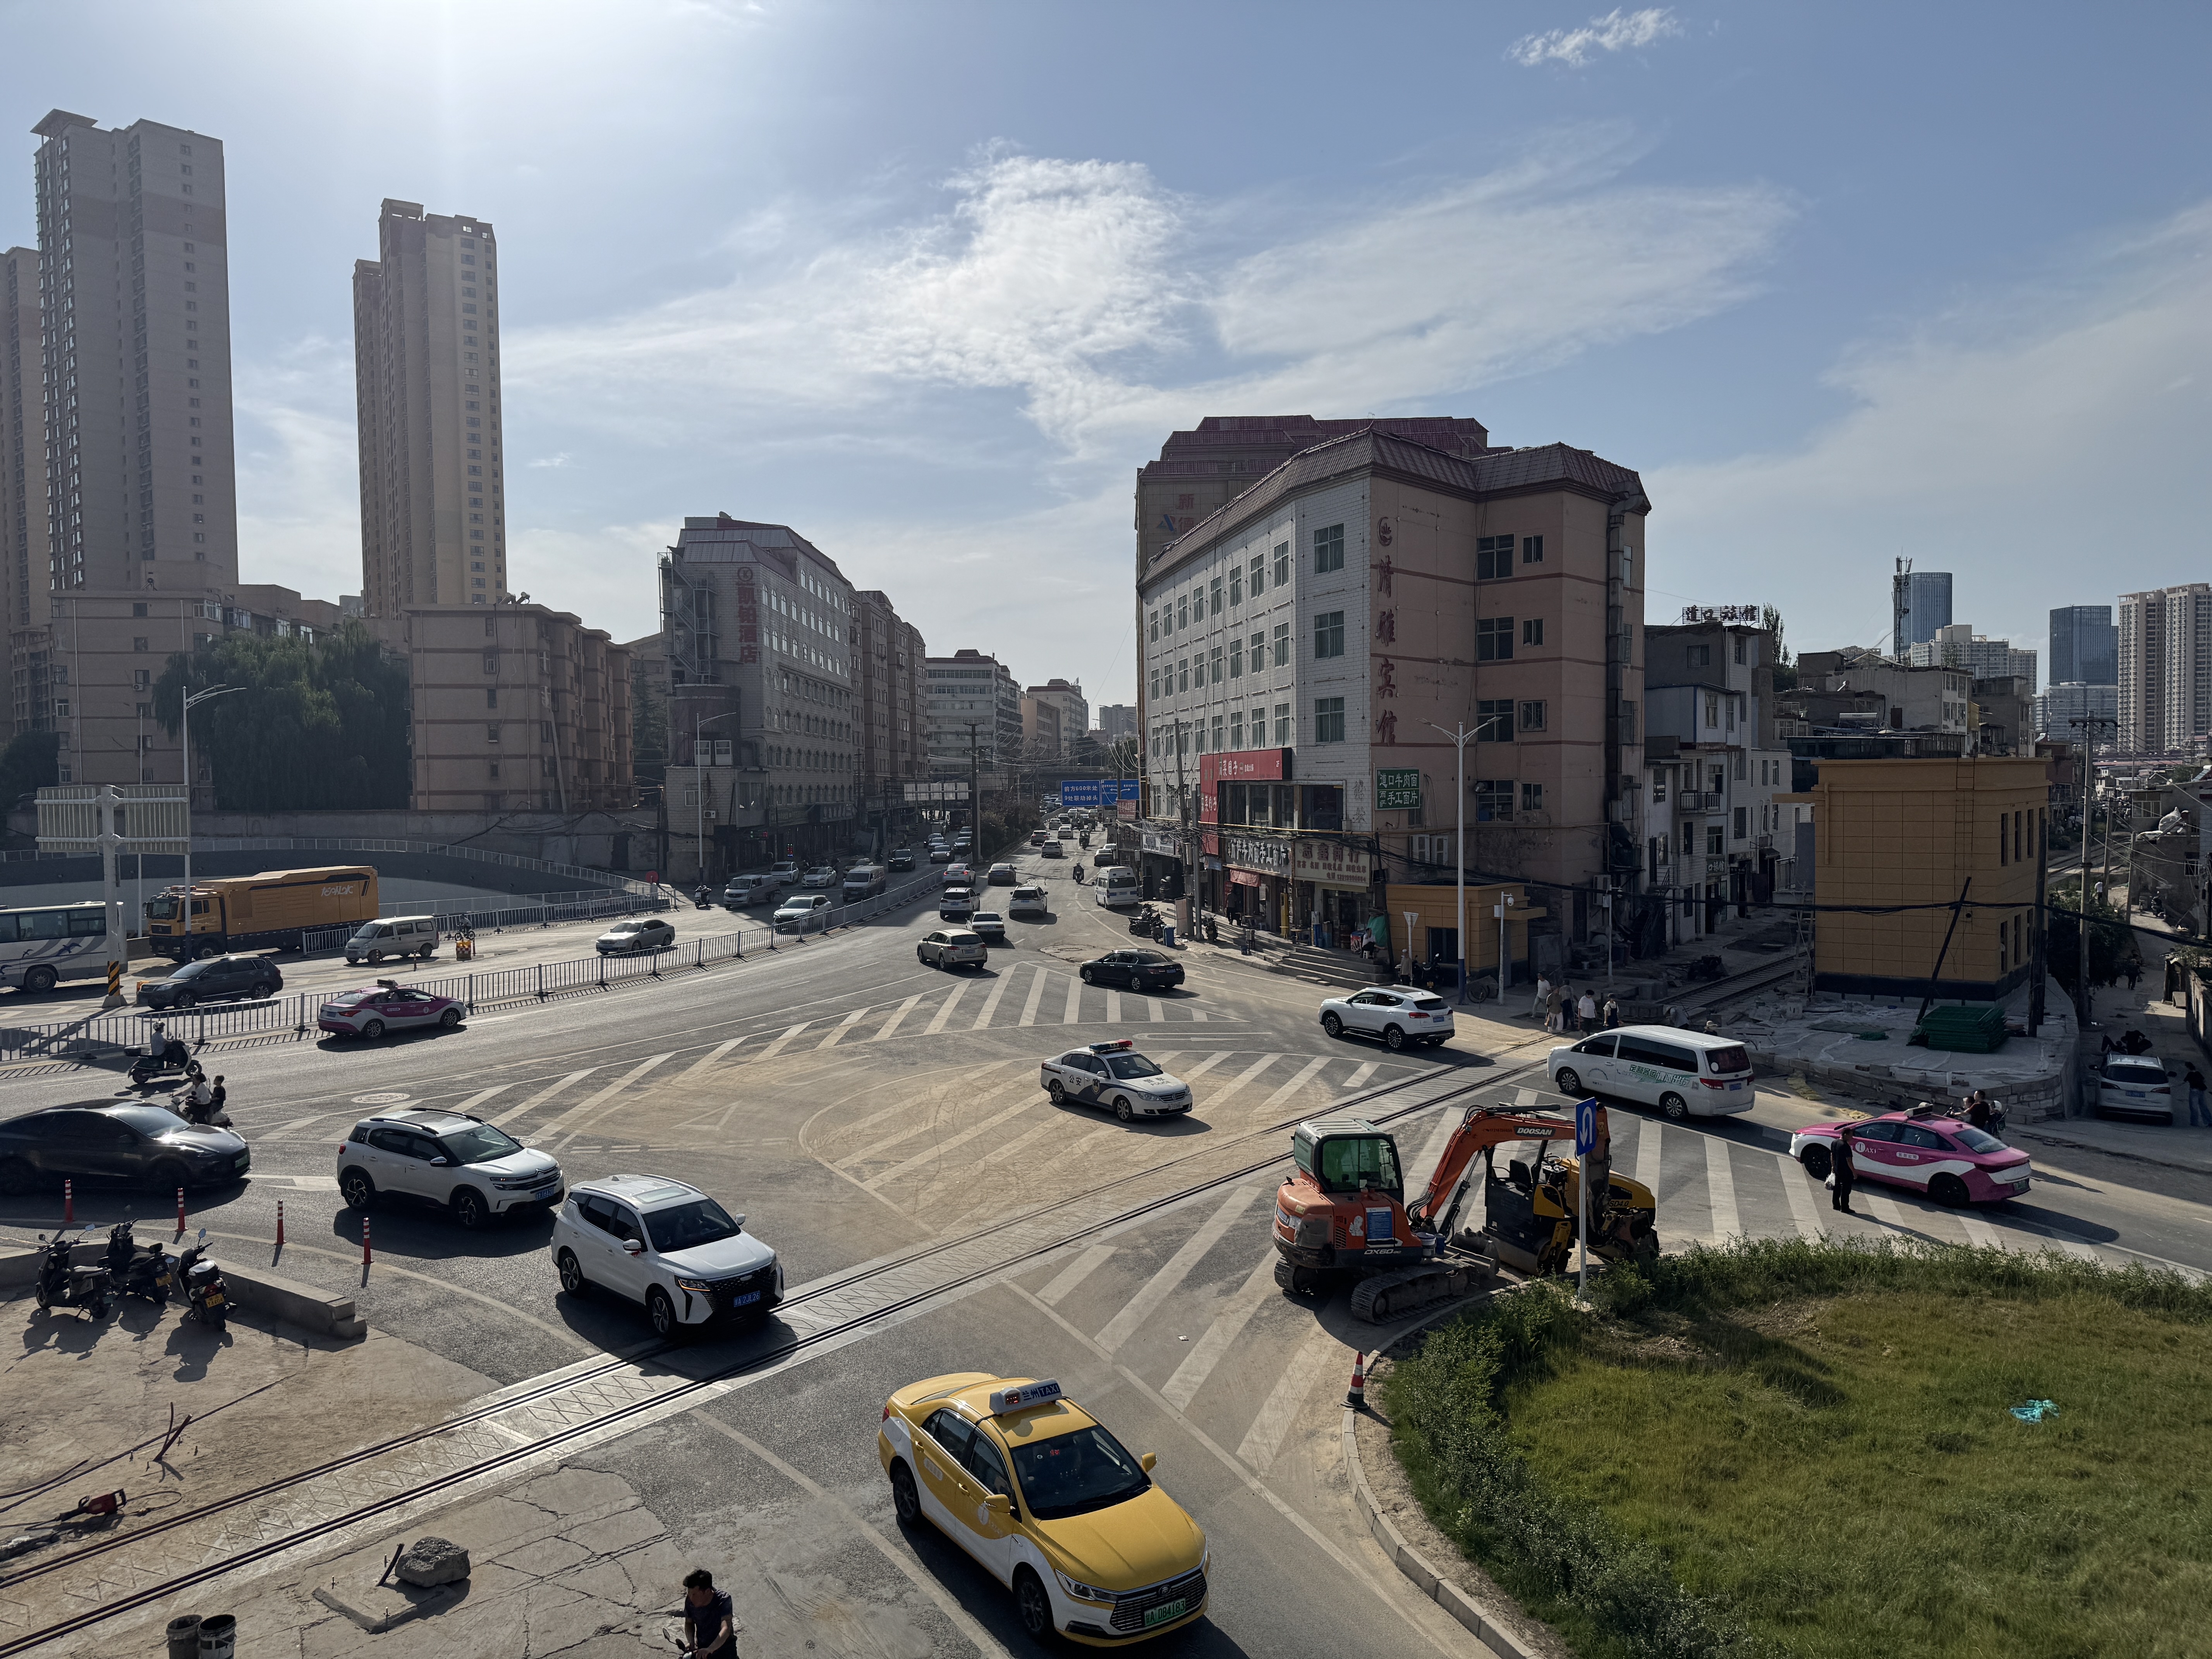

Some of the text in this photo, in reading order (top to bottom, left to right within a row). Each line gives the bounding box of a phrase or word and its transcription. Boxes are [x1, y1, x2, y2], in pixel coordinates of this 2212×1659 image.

[1379, 773, 1418, 788] 道口牛肉面
[1387, 790, 1418, 805] 手工面片
[1069, 1075, 1082, 1086] 公安
[1516, 1127, 1553, 1135] DOOSAN
[1022, 1388, 1040, 1401] 兰州
[1039, 1384, 1060, 1396] TAXI
